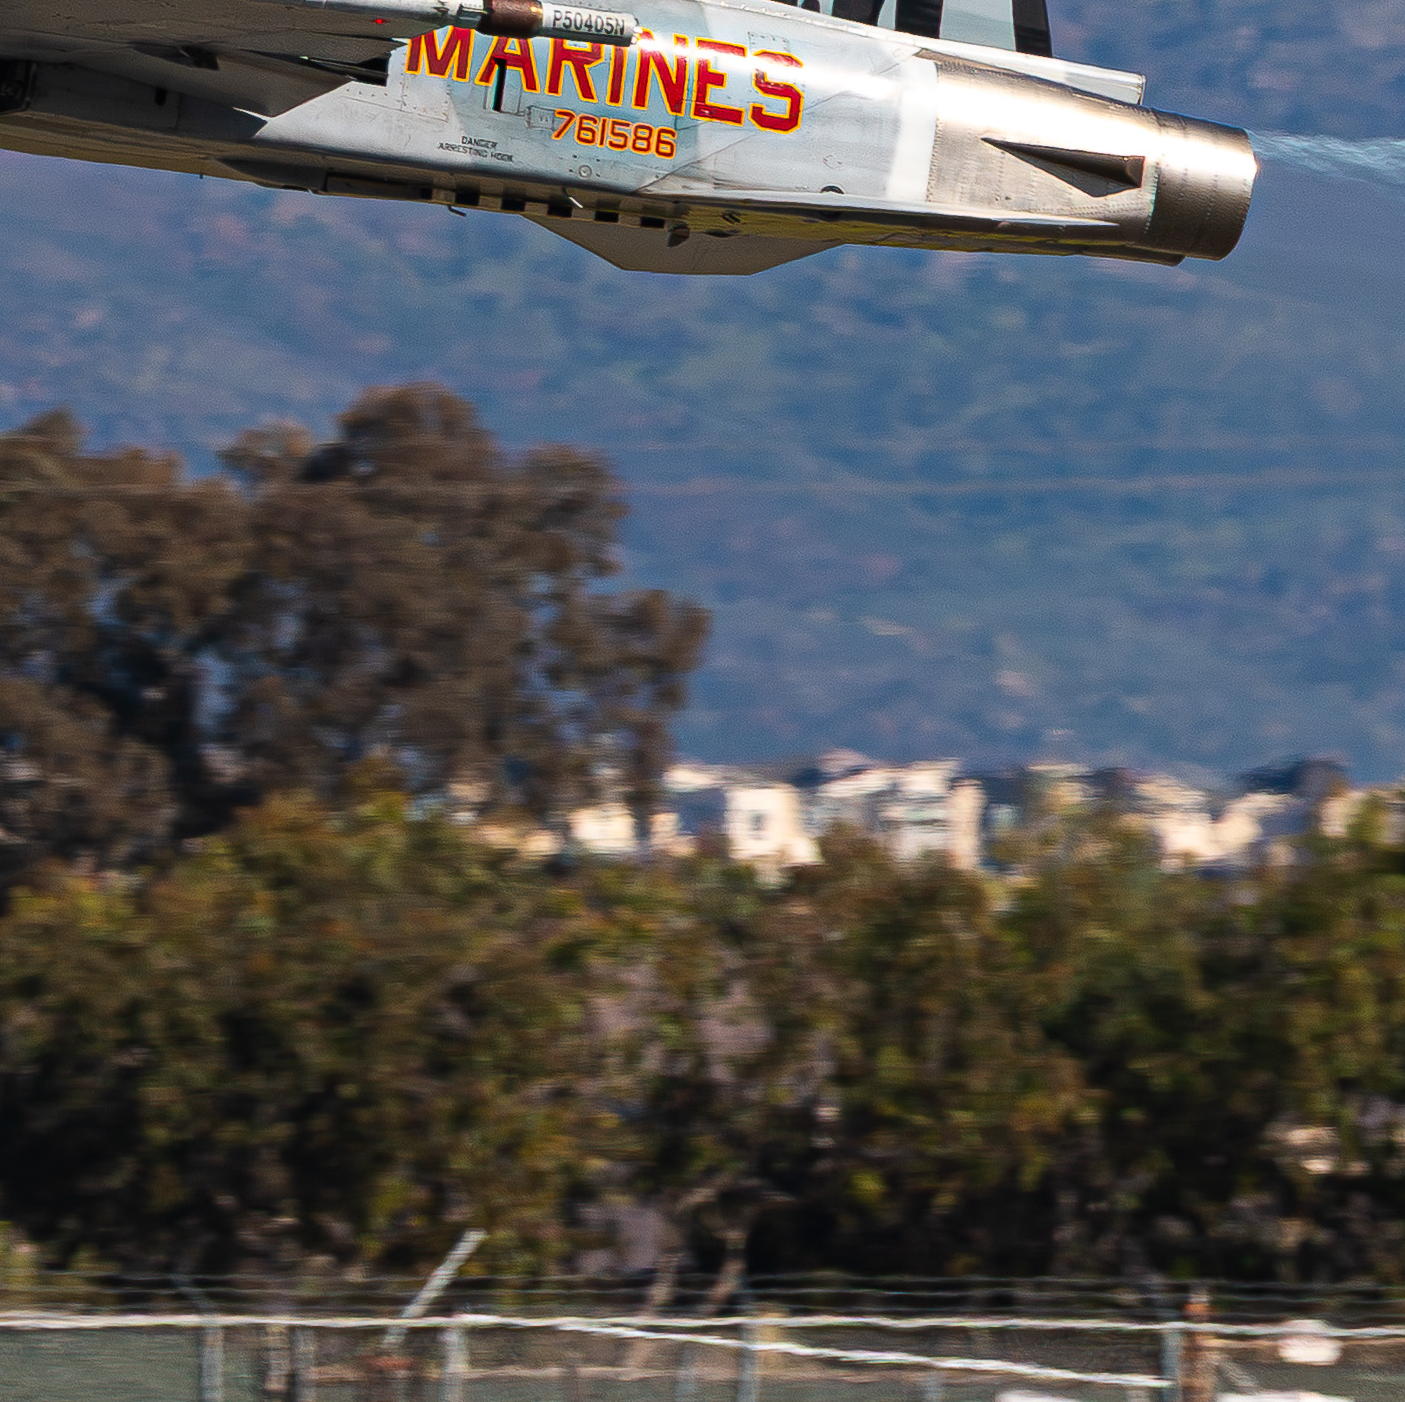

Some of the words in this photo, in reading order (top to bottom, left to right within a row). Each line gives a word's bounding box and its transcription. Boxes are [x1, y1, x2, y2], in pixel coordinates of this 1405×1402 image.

[405, 25, 804, 135] MARINES
[437, 142, 488, 158] ARRESTING
[460, 136, 499, 151] DANGER
[552, 109, 678, 160] 761586
